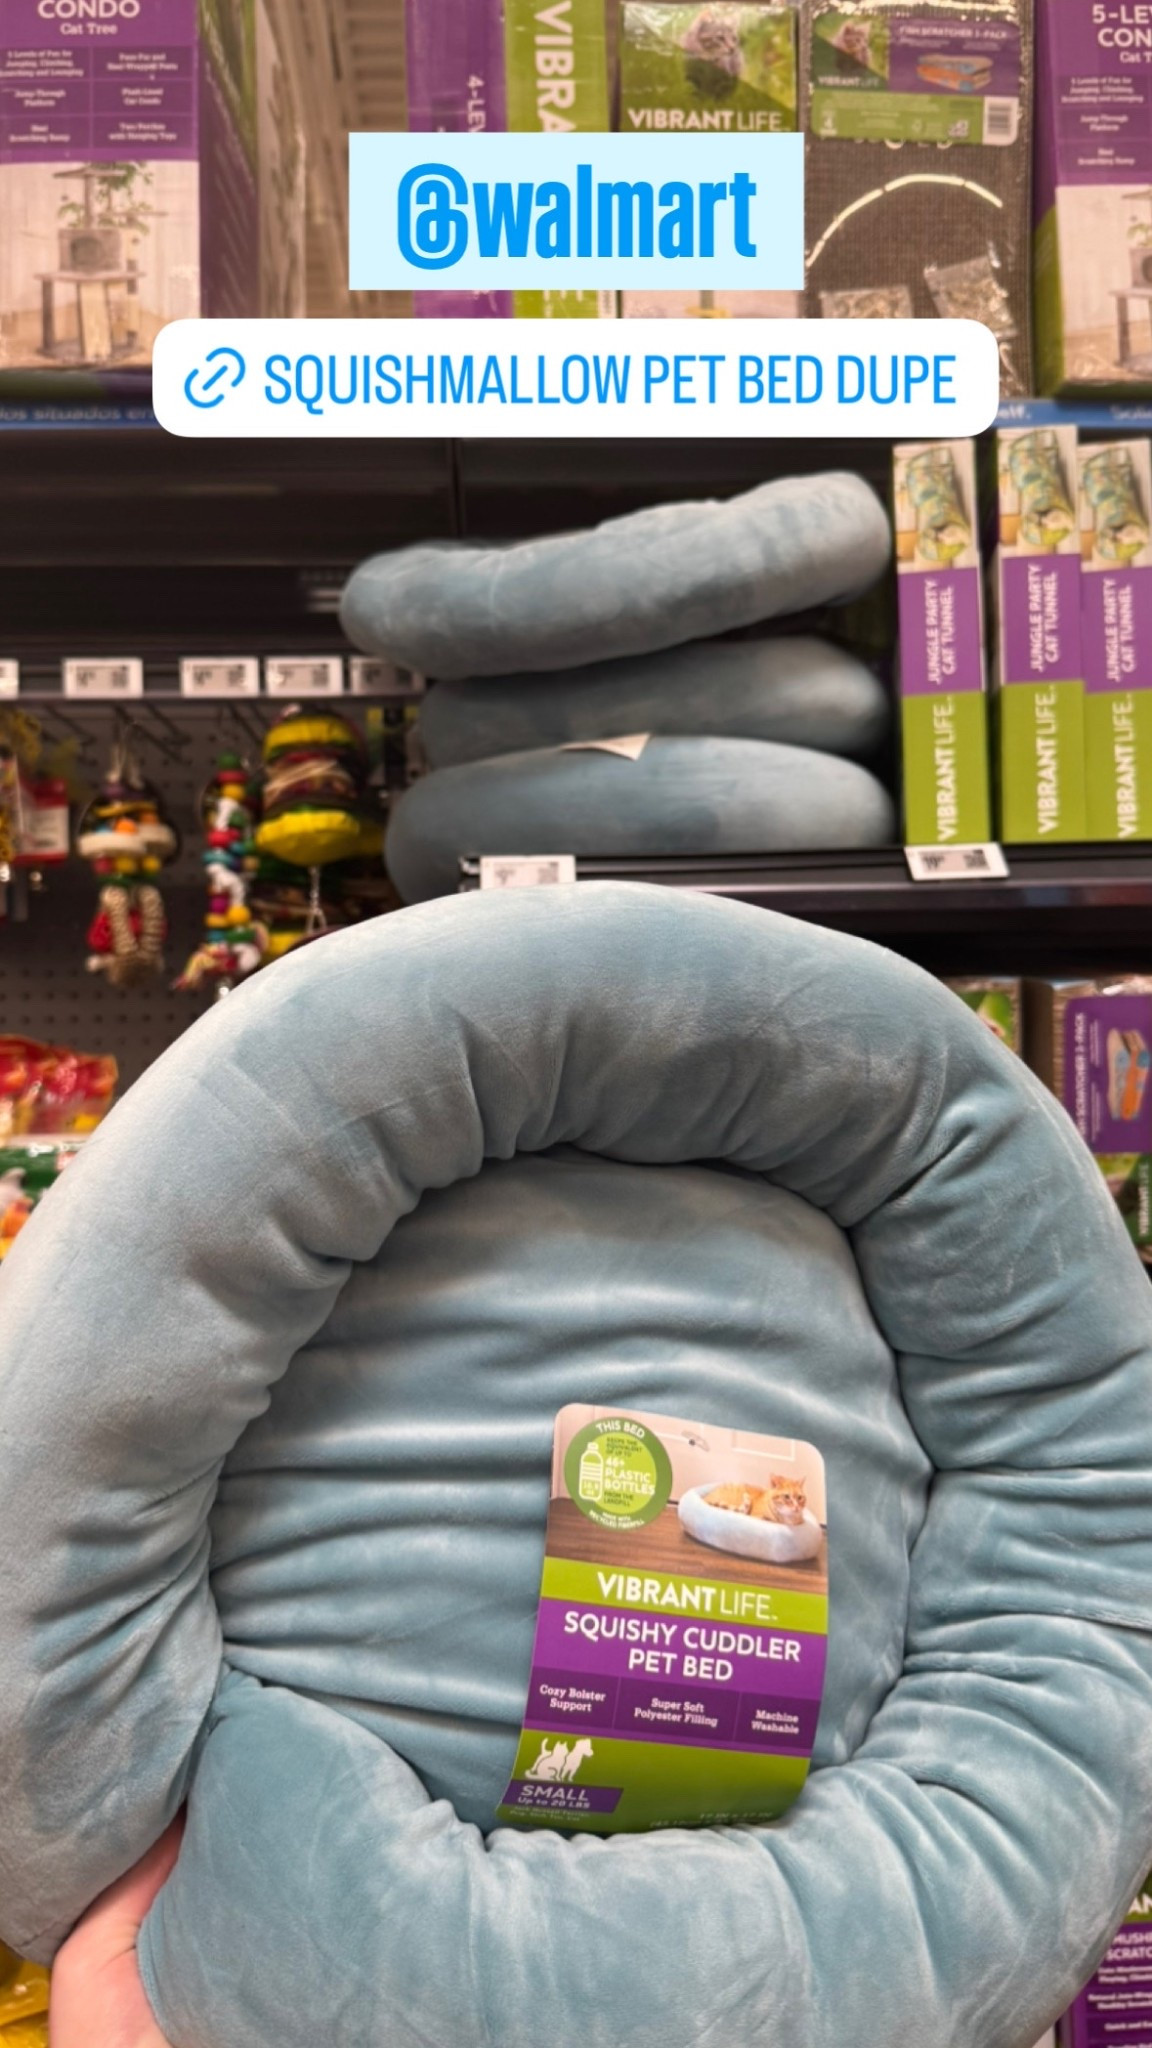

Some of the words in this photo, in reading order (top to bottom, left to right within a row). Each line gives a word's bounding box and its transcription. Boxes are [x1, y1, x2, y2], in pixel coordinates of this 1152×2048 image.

[38, 0, 140, 18] CONDO
[60, 23, 83, 35] Cat
[86, 23, 118, 35] Tree
[1120, 51, 1140, 63] Cat
[628, 108, 734, 129] VIBRANT
[1028, 563, 1042, 612] PARTY
[925, 579, 939, 626] PARTY
[940, 587, 955, 645] TUNNEL
[1044, 572, 1058, 633] TUNNEL
[1103, 578, 1117, 627] PARTY
[1118, 584, 1134, 643] TUNNEL
[927, 628, 942, 685] JUNGLE
[1030, 614, 1044, 673] JUNGLE
[1045, 634, 1059, 664] CAT
[1105, 628, 1120, 683] JUNGLE
[942, 647, 957, 675] CAT
[1121, 645, 1135, 673] CAT
[934, 749, 958, 841] VIBRANT
[1037, 737, 1059, 834] VIBRANT
[1115, 745, 1138, 838] VIBRANT
[596, 1420, 621, 1434] THIS
[624, 1422, 645, 1438] BED
[604, 1478, 656, 1495] BOTTLES
[605, 1467, 651, 1484] PLASTIC
[597, 1571, 716, 1612] VIBRANT
[564, 1610, 678, 1647] SQUISHY
[683, 1626, 801, 1662] CUDDLER
[628, 1649, 677, 1674] PET
[682, 1656, 733, 1681] BED
[540, 1684, 566, 1700] Cozy
[569, 1686, 606, 1702] Bolster
[549, 1697, 592, 1713] Support
[651, 1698, 679, 1713] Super
[682, 1700, 705, 1713] Soft
[634, 1707, 681, 1725] Polyester
[683, 1711, 718, 1728] Filling
[751, 1720, 799, 1735] Washable
[755, 1708, 799, 1724] Machine
[517, 1796, 533, 1806] Up
[568, 1801, 591, 1810] LBS
[521, 1784, 589, 1802] SMALL
